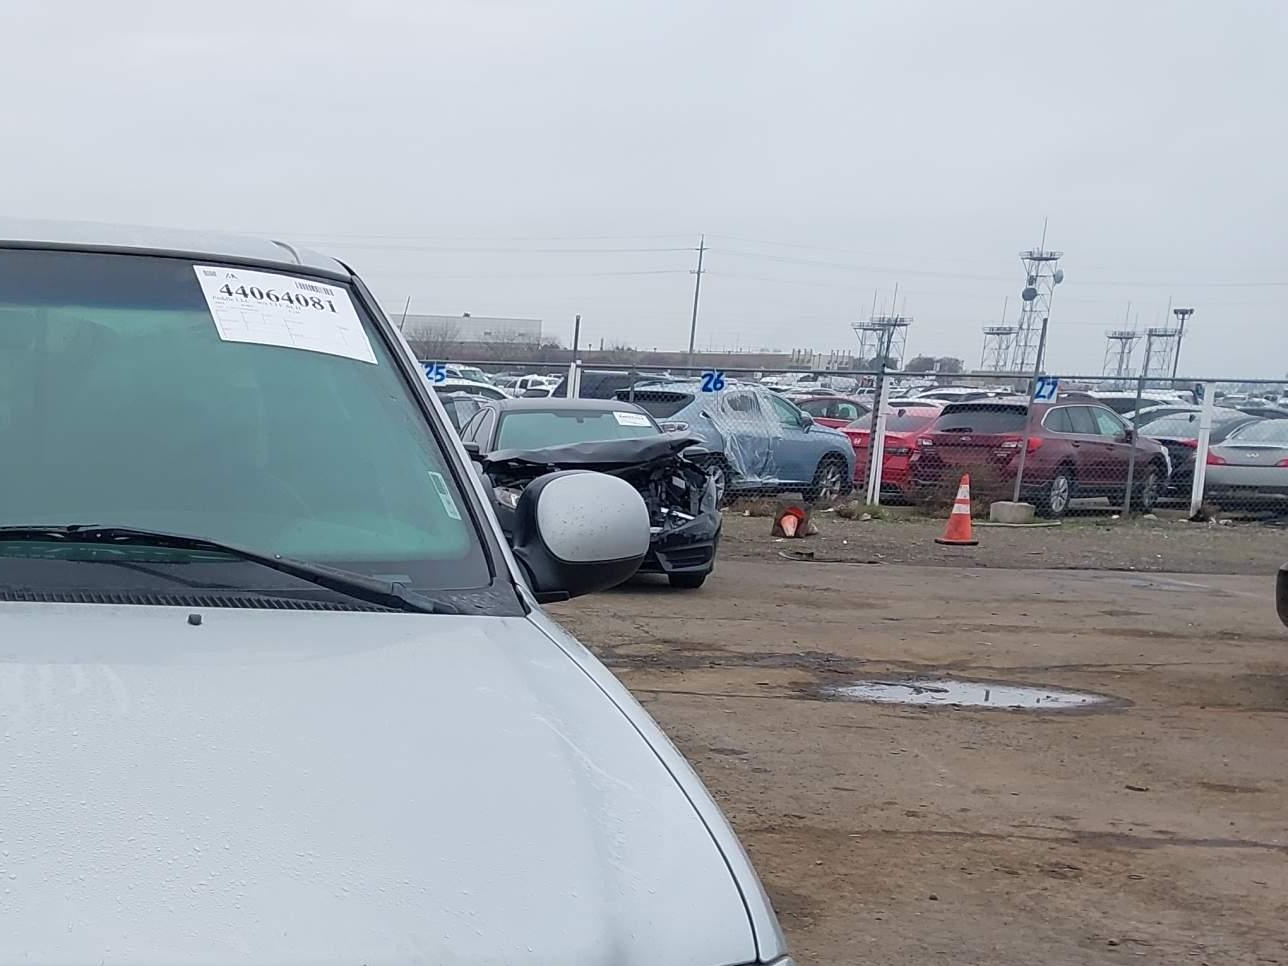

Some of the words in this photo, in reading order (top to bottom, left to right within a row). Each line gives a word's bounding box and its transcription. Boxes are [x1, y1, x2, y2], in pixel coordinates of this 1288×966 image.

[219, 283, 337, 313] 44064081
[424, 364, 446, 383] 25
[702, 372, 725, 393] 26
[1034, 377, 1059, 400] 27
